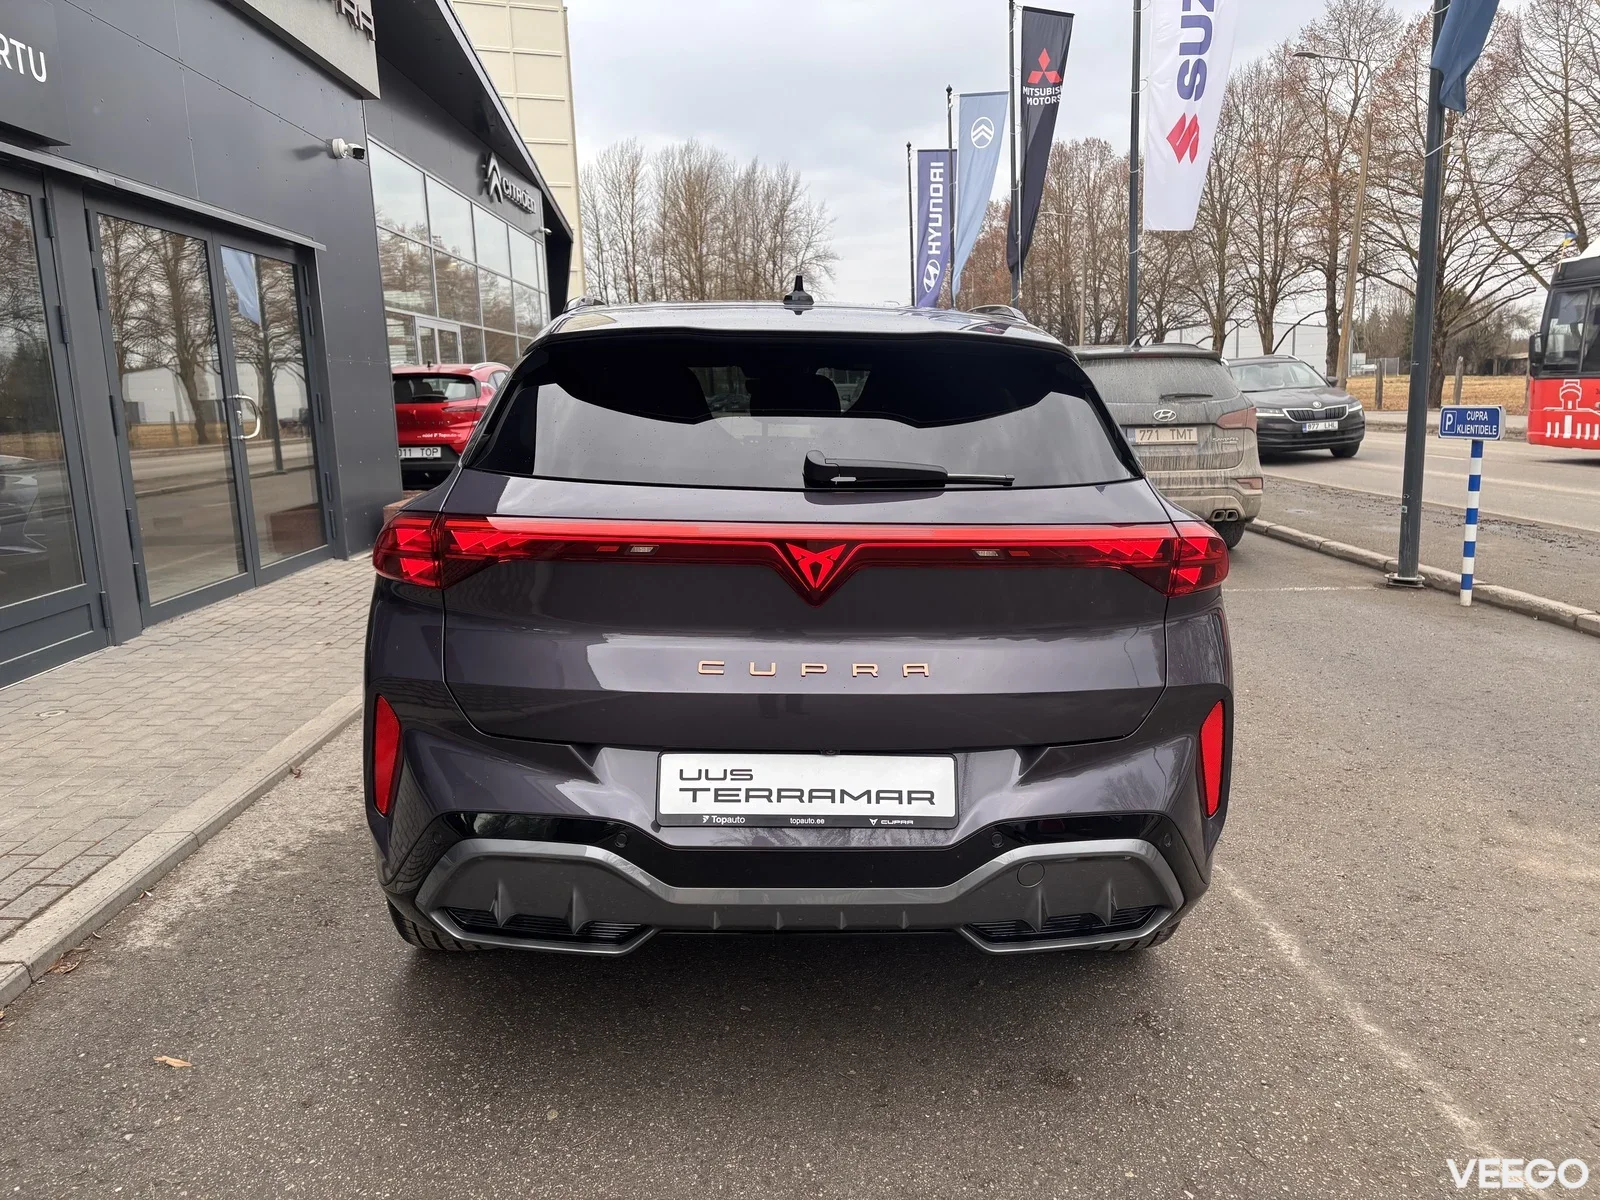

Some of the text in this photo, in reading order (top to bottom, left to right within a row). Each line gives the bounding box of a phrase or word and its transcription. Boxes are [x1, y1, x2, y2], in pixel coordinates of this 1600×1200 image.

[0, 33, 47, 83] RTU
[1022, 86, 1063, 97] MITSUBIS
[1026, 94, 1062, 106] MOTORS
[928, 162, 944, 255] HYUNDAI
[1445, 413, 1453, 431] P
[1466, 411, 1488, 421] CUPRA
[1139, 429, 1160, 441] 771
[1169, 428, 1194, 440] TMT
[1456, 424, 1497, 435] KLIENTIDELE
[420, 448, 439, 457] TOP
[698, 660, 931, 678] CUPRA
[679, 768, 754, 782] UUS
[678, 787, 936, 806] TERRAMAR
[711, 815, 746, 825] Topauto
[789, 817, 826, 826] topauto.ee
